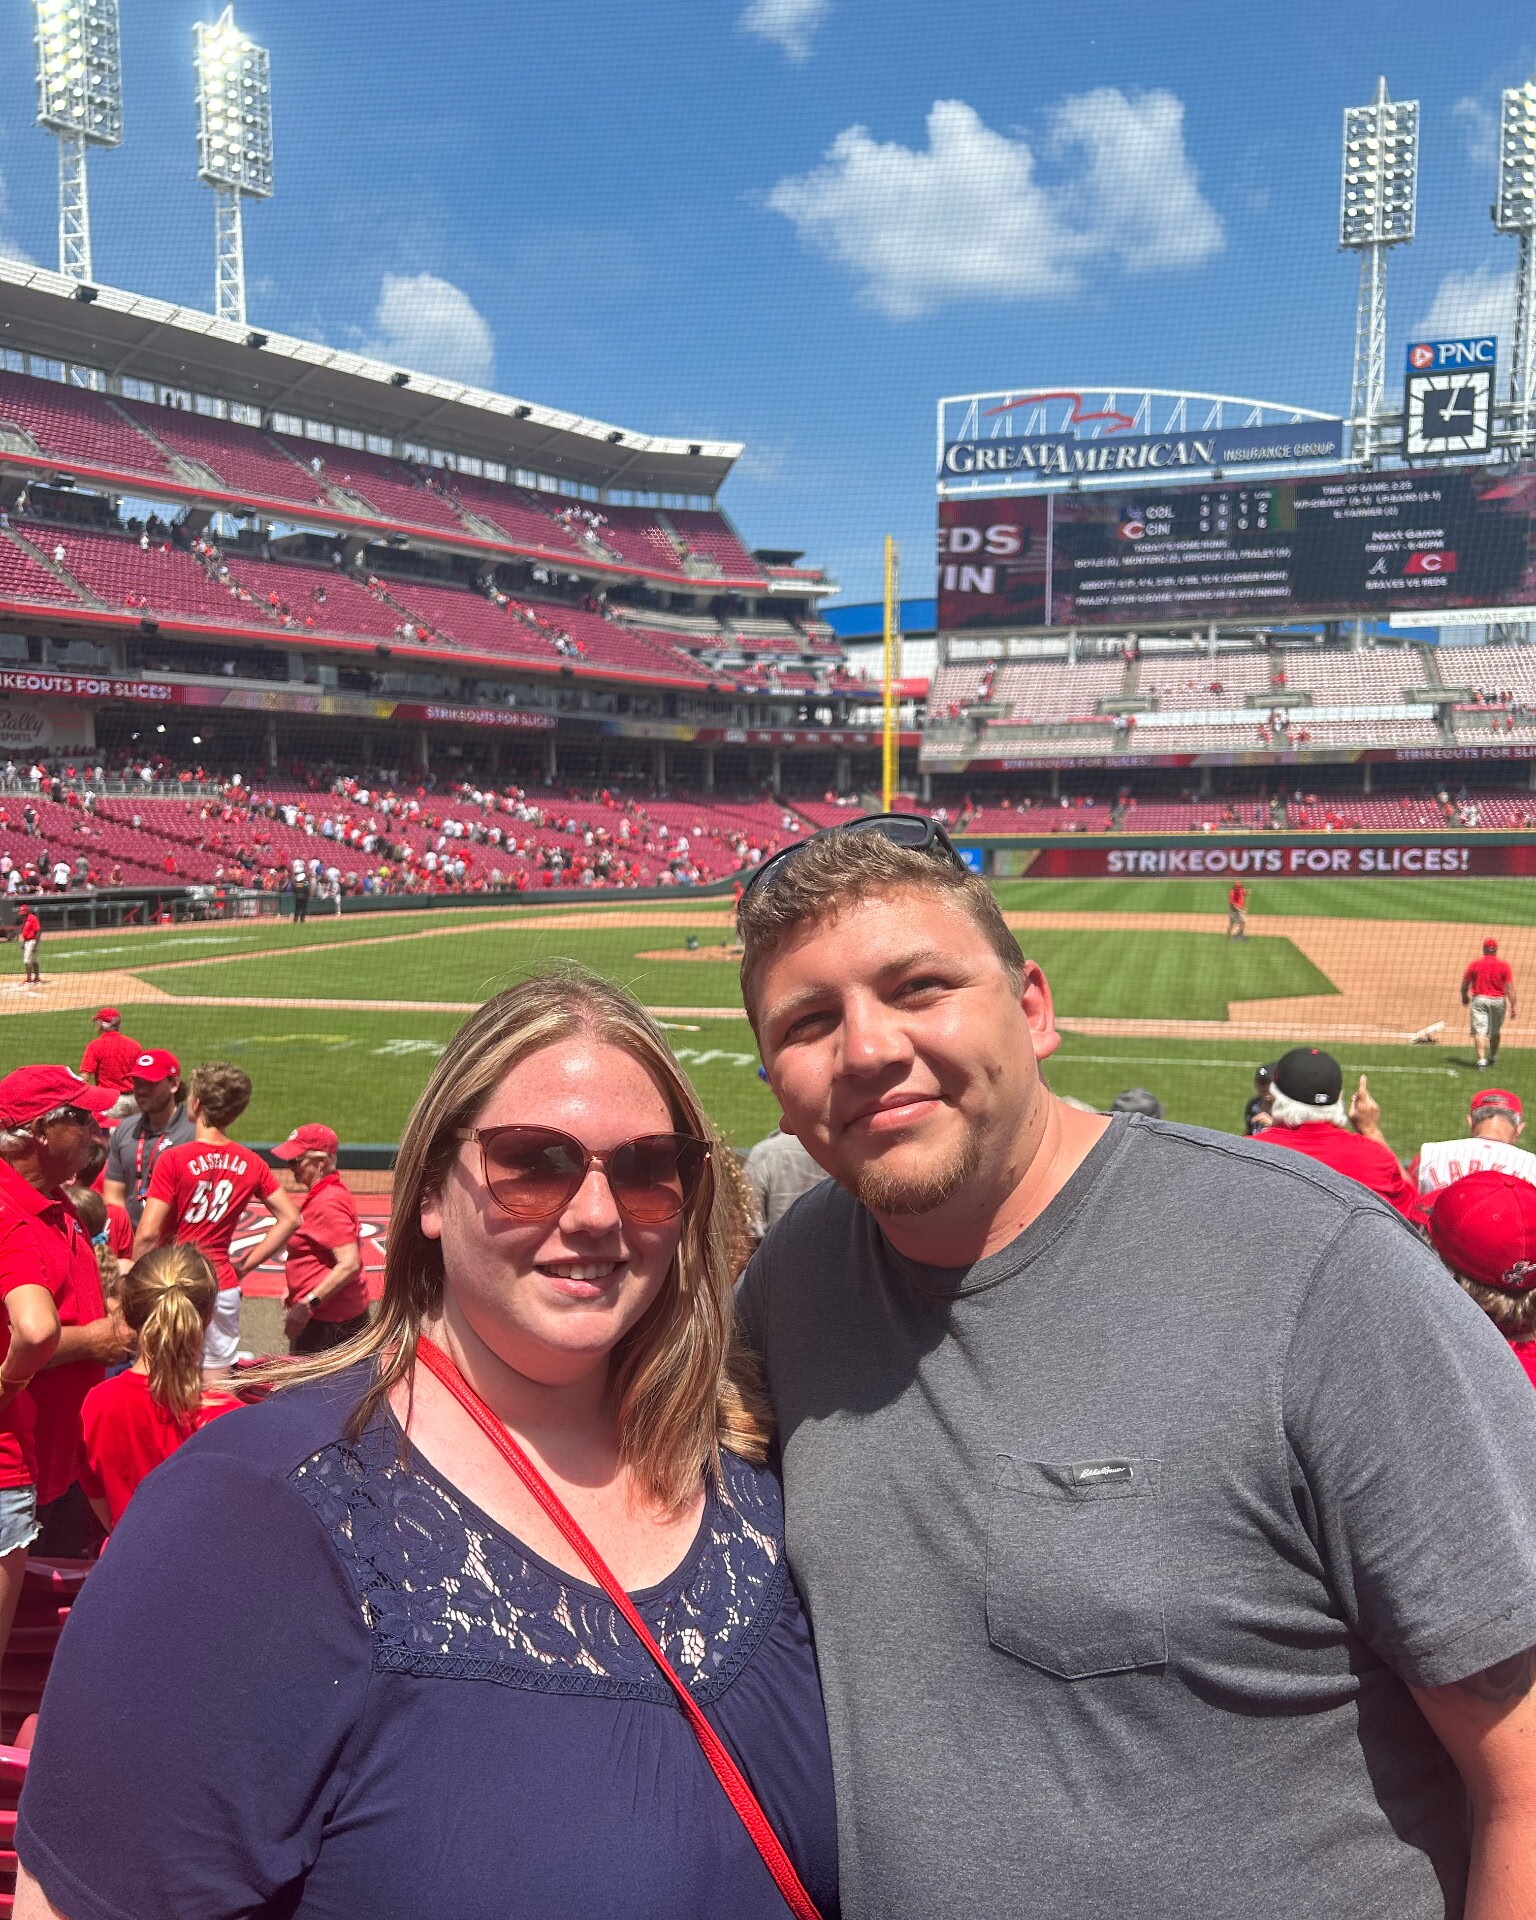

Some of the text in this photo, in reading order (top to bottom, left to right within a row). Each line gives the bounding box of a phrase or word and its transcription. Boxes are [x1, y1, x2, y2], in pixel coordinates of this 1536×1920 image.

[1437, 340, 1494, 364] PNC
[945, 437, 1336, 474] GREAT AMERICAN INSURANCE GROUP
[1146, 506, 1175, 519] COL
[1145, 522, 1171, 536] CIN
[1371, 528, 1445, 541] Next Game
[1365, 541, 1400, 553] FRIDAY
[1421, 554, 1442, 571] C
[937, 564, 995, 594] IN
[1365, 579, 1405, 590] BRAVES
[1422, 576, 1448, 587] REDS
[1442, 613, 1510, 623] ULTIMATE
[77, 680, 111, 695] FOR
[114, 682, 172, 699] SLICES!
[0, 711, 44, 737] Bally
[426, 705, 496, 724] STRIKEOUTS
[497, 711, 520, 725] FOR
[1396, 748, 1479, 761] STRIKEOUTS
[1481, 747, 1510, 759] FOR
[1107, 847, 1470, 872] STRIKEOUTS FOR SLICES!
[188, 1152, 248, 1176] CASTILLO
[1428, 1158, 1526, 1190] LARK
[185, 1179, 233, 1224] 58
